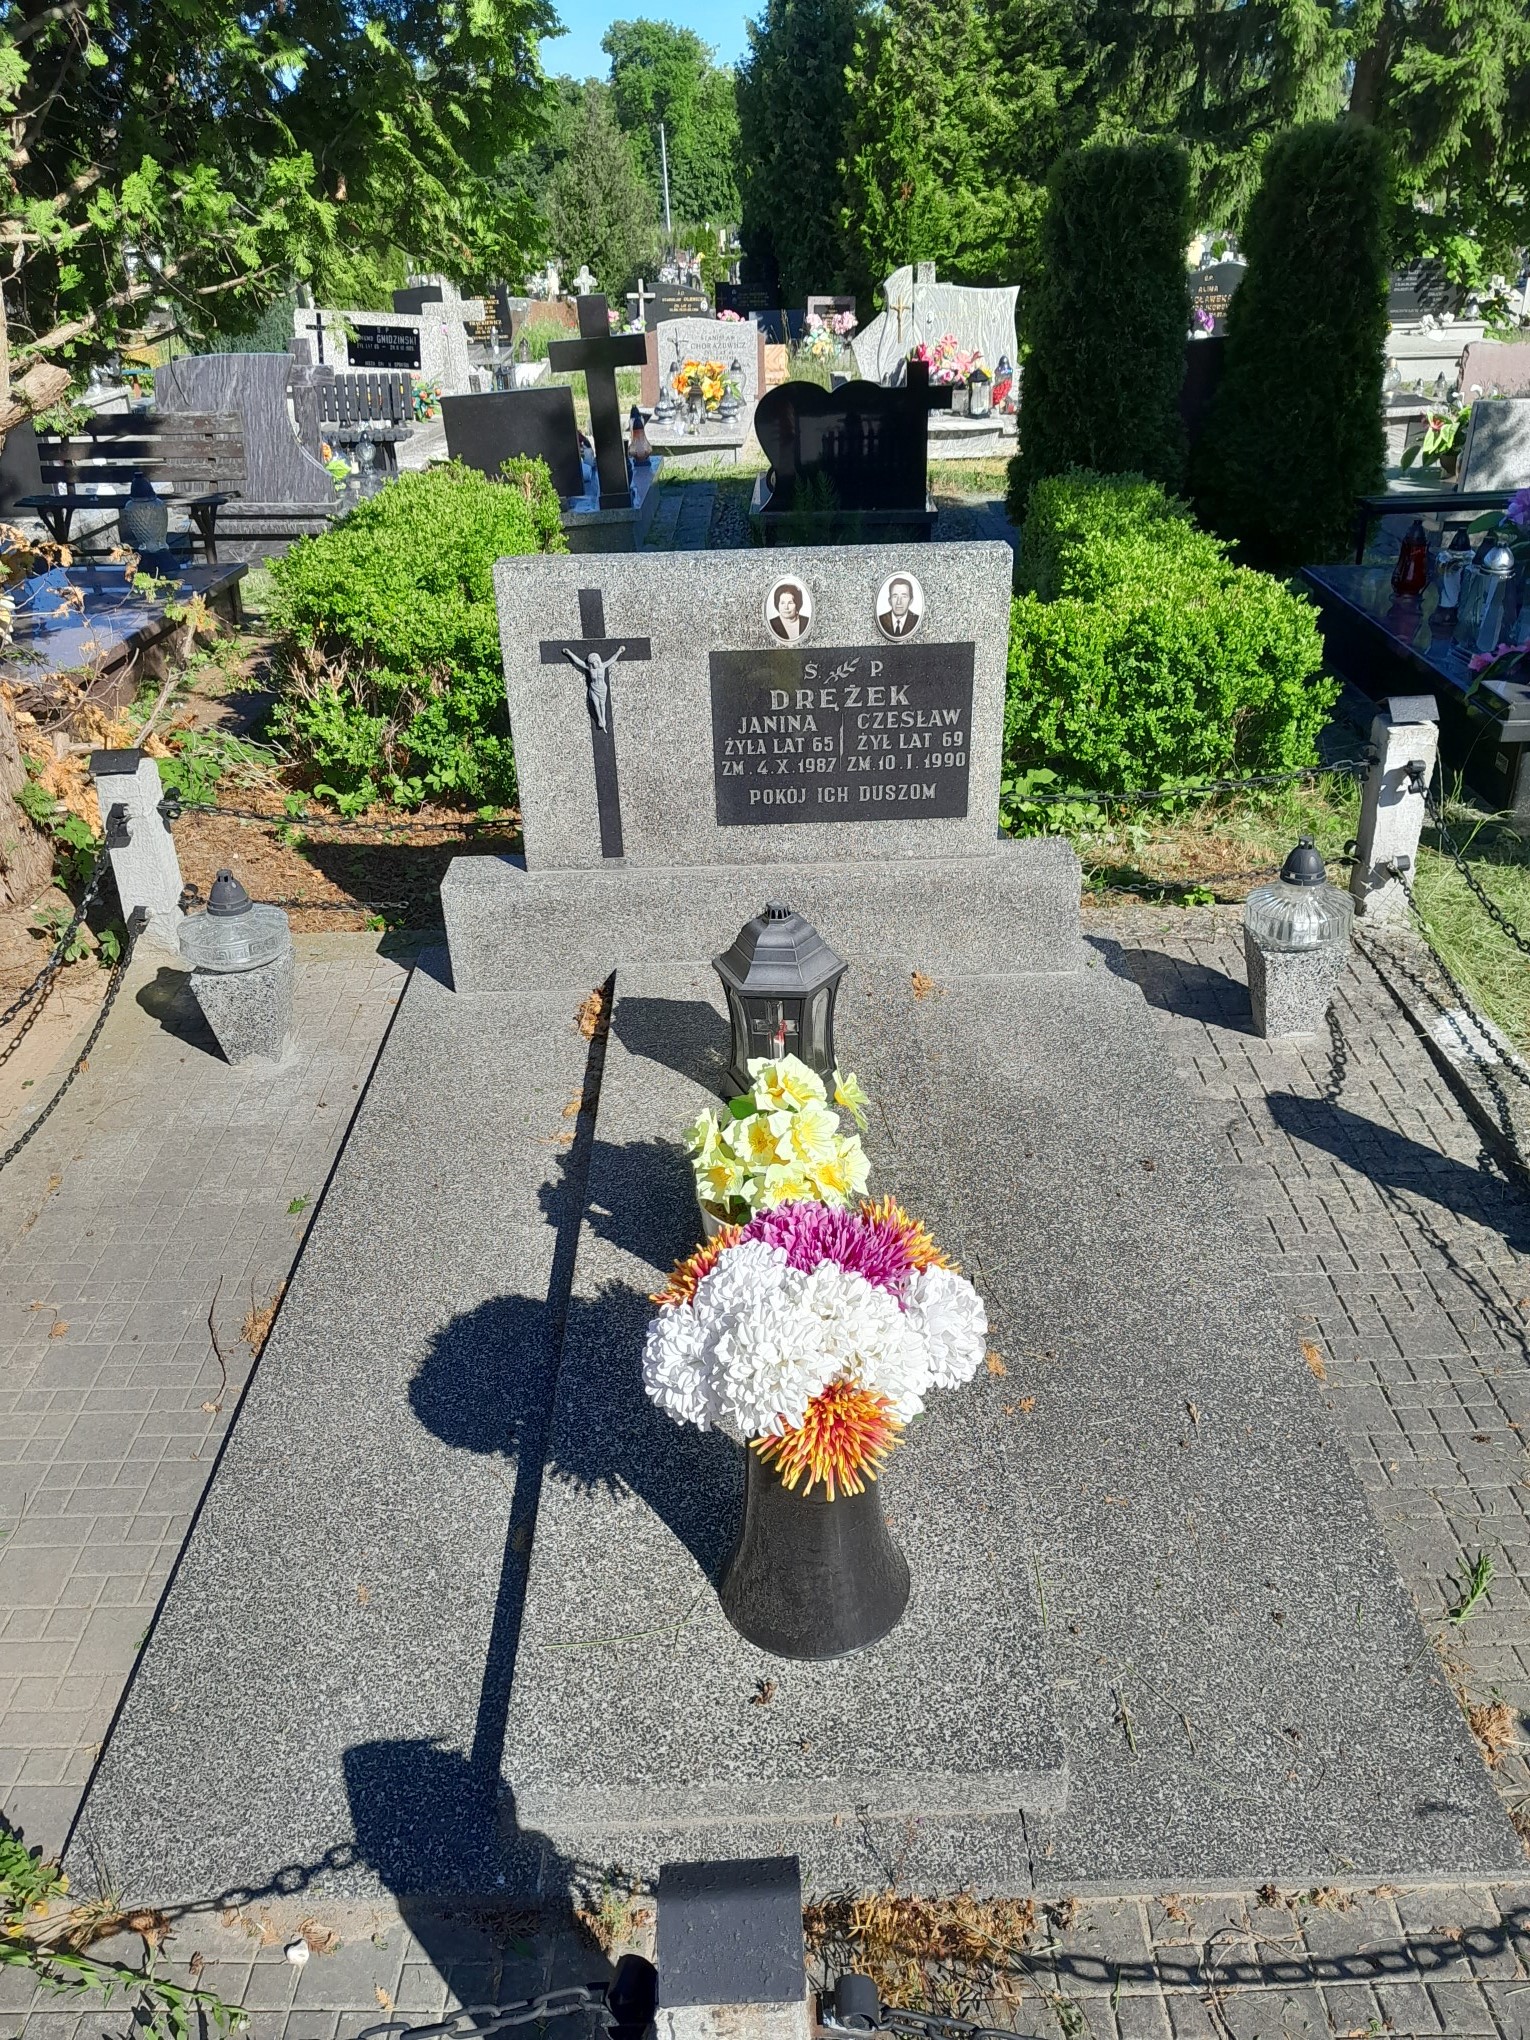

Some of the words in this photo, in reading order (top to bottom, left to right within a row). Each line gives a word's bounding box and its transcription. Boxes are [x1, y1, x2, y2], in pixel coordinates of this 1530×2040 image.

[769, 684, 911, 712] DRĘŻEK
[738, 714, 818, 735] JANINA
[857, 708, 962, 729] CZESŁAW
[724, 737, 767, 755] ŻYŁA
[773, 737, 805, 754] LAT
[812, 736, 834, 752] 65
[857, 732, 893, 750] ŻYŁ
[899, 732, 932, 749] LAT
[942, 731, 964, 747] 69
[749, 785, 807, 805] POKÓJ
[817, 786, 849, 803] ICH
[859, 783, 938, 802] DUSZOM
